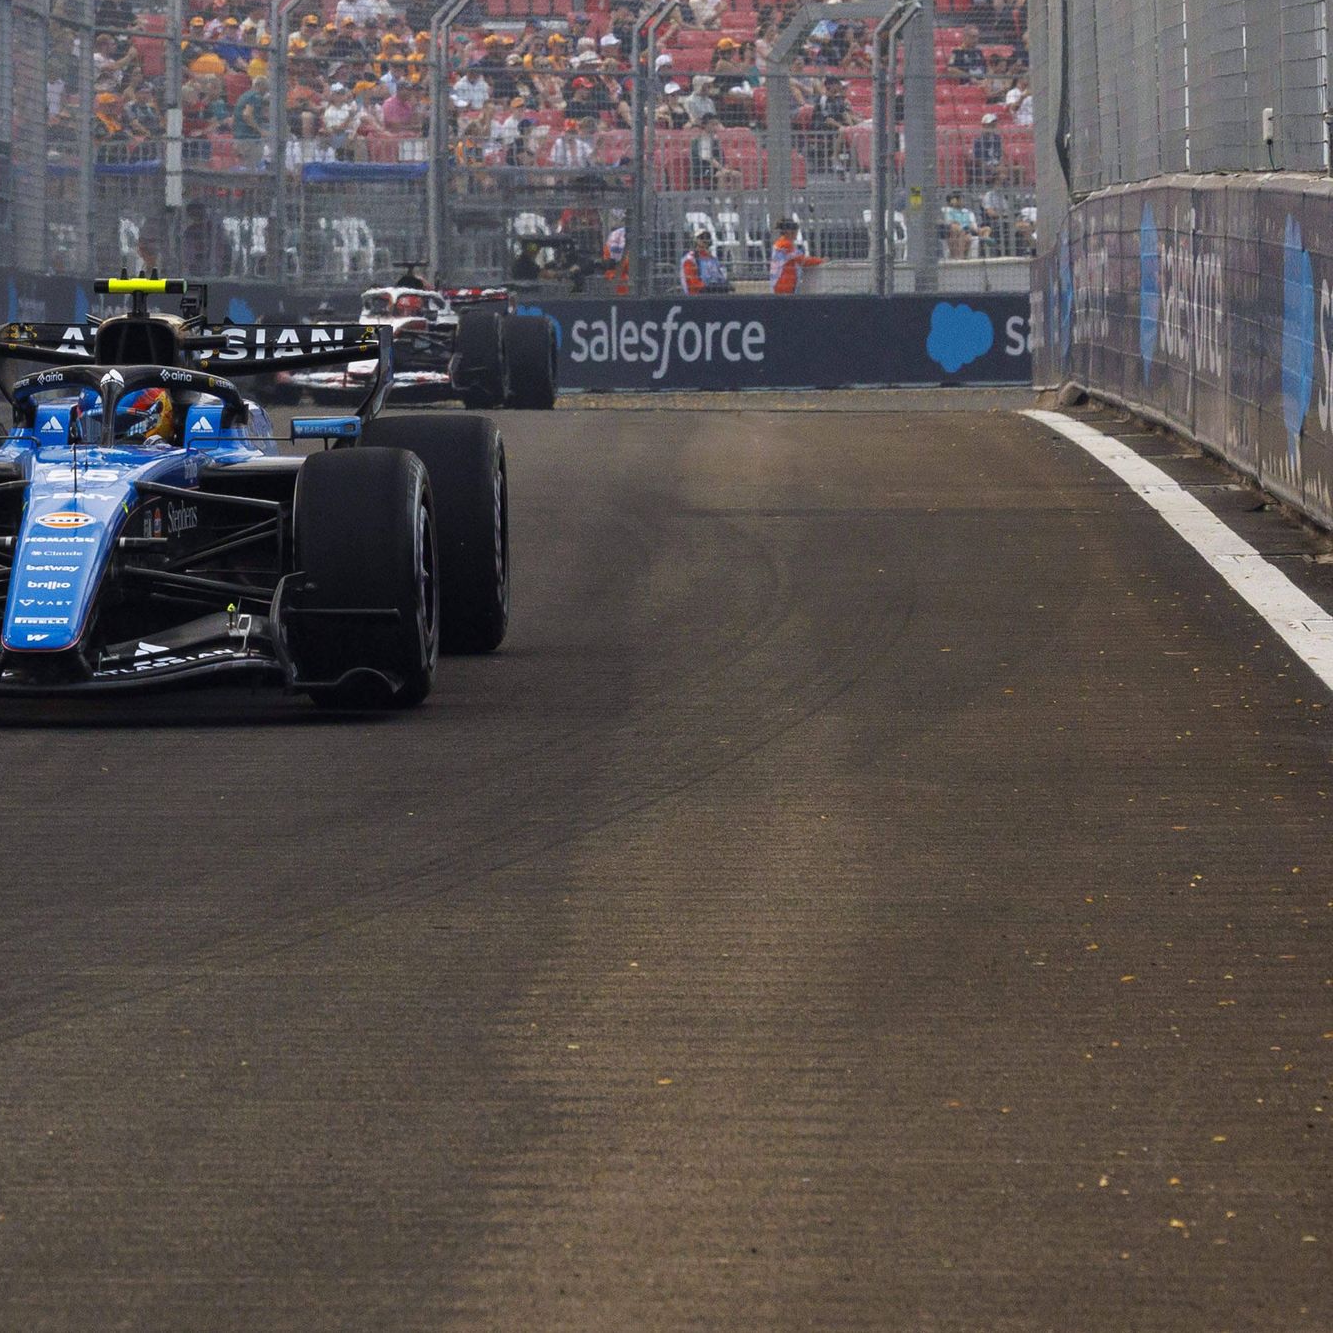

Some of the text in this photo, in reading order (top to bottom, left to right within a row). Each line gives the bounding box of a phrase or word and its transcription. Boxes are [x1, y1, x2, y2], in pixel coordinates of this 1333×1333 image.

[571, 306, 766, 379] salesforce
[46, 372, 64, 383] airia
[171, 371, 193, 382] airia
[304, 426, 341, 434] BARCLAYS
[167, 500, 198, 538] Stephens
[25, 564, 80, 572] betway
[27, 581, 71, 589] brillio
[93, 648, 235, 677] ATLASSIAN
